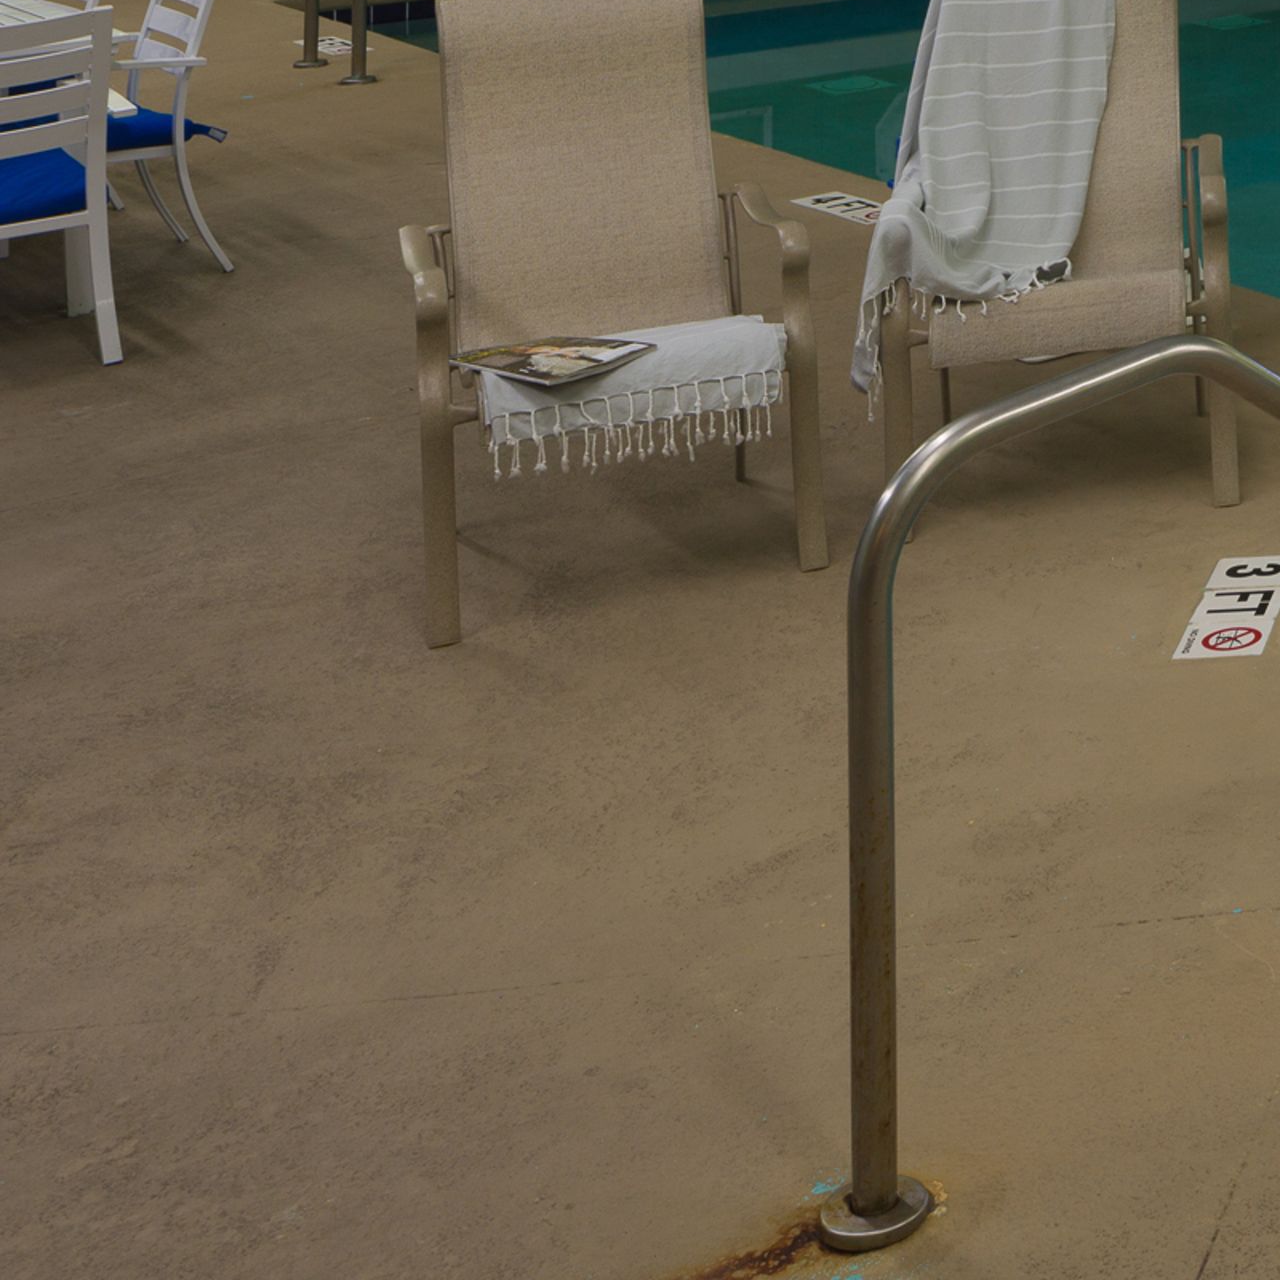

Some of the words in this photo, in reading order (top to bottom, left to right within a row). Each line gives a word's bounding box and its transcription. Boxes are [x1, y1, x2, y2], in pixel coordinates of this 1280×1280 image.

[811, 195, 847, 206] 4
[826, 199, 880, 214] FT
[1205, 589, 1275, 617] FT
